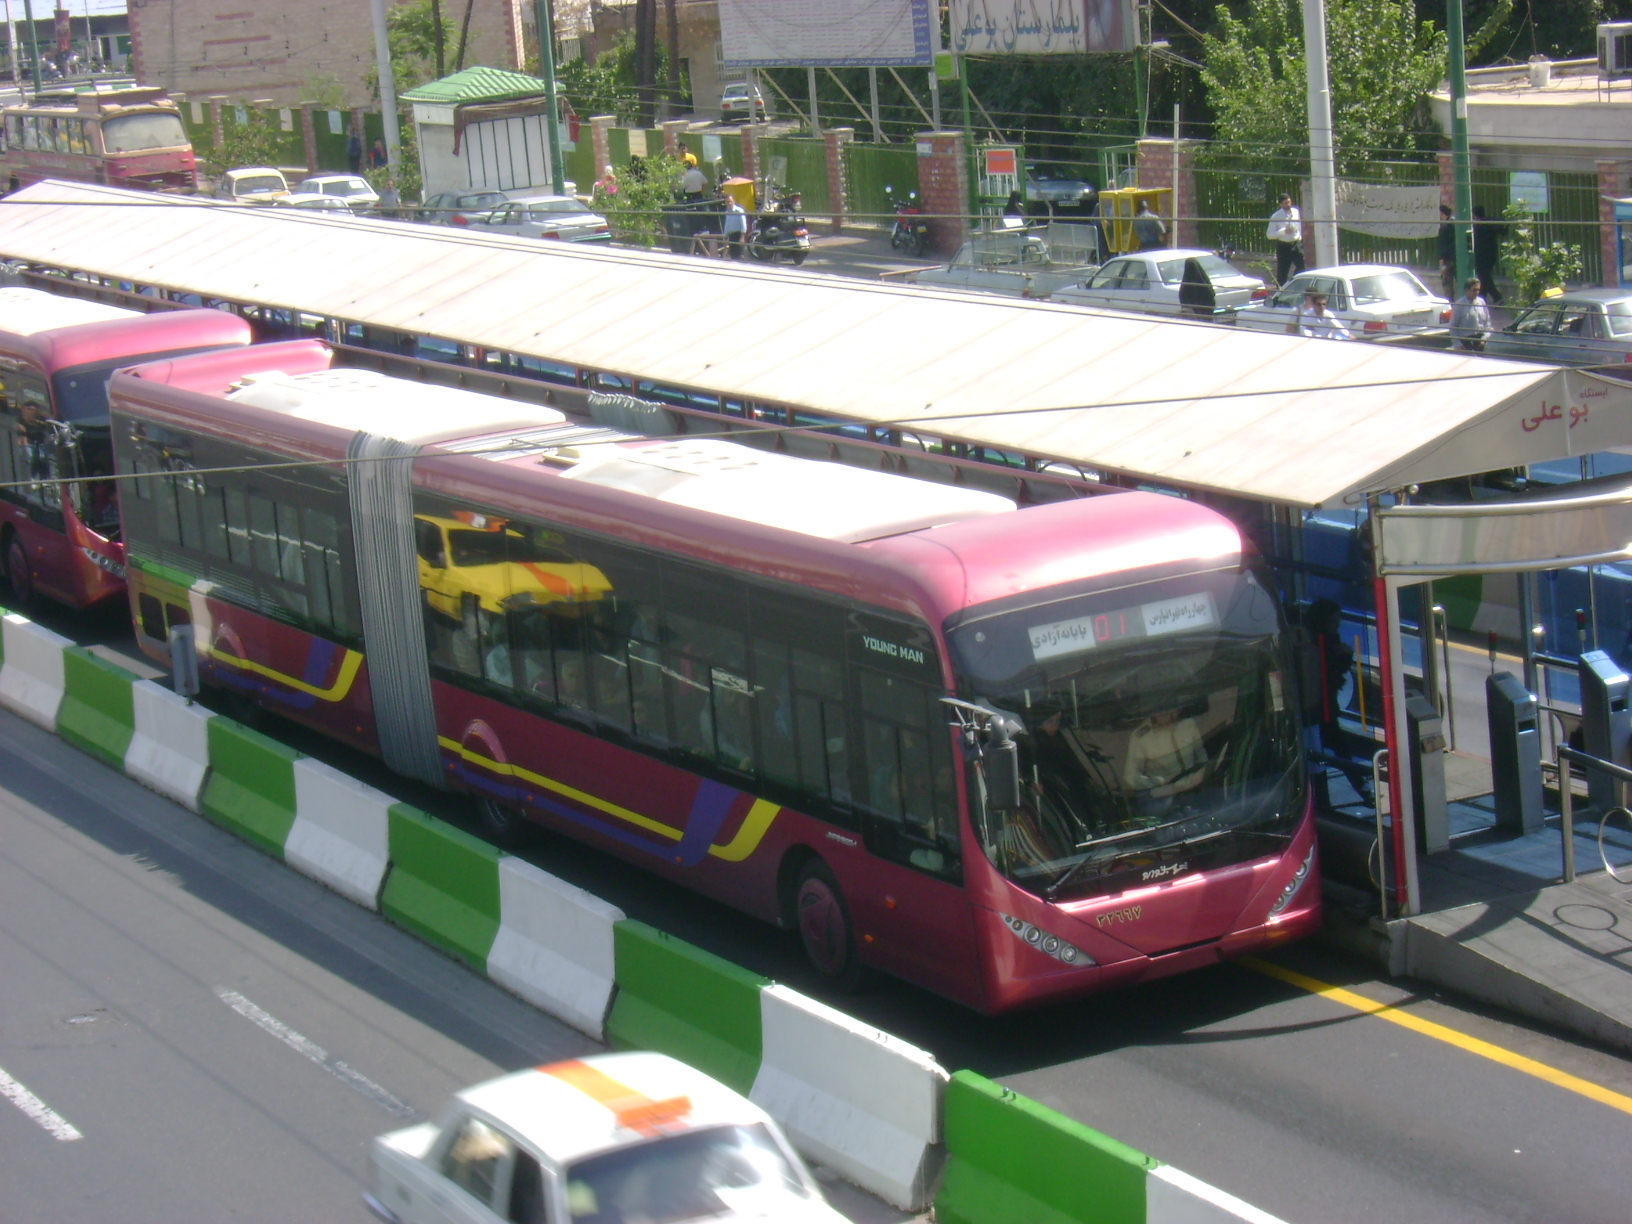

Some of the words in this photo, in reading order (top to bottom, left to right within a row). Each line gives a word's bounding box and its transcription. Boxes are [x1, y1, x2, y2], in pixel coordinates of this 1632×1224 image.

[1003, 0, 1080, 50] بیمارستان
[1580, 387, 1608, 399] ایستگاه
[1032, 624, 1061, 649] آزادی
[1061, 624, 1087, 640] پایانه
[862, 635, 897, 656] YOUNG
[899, 645, 925, 665] MAN
